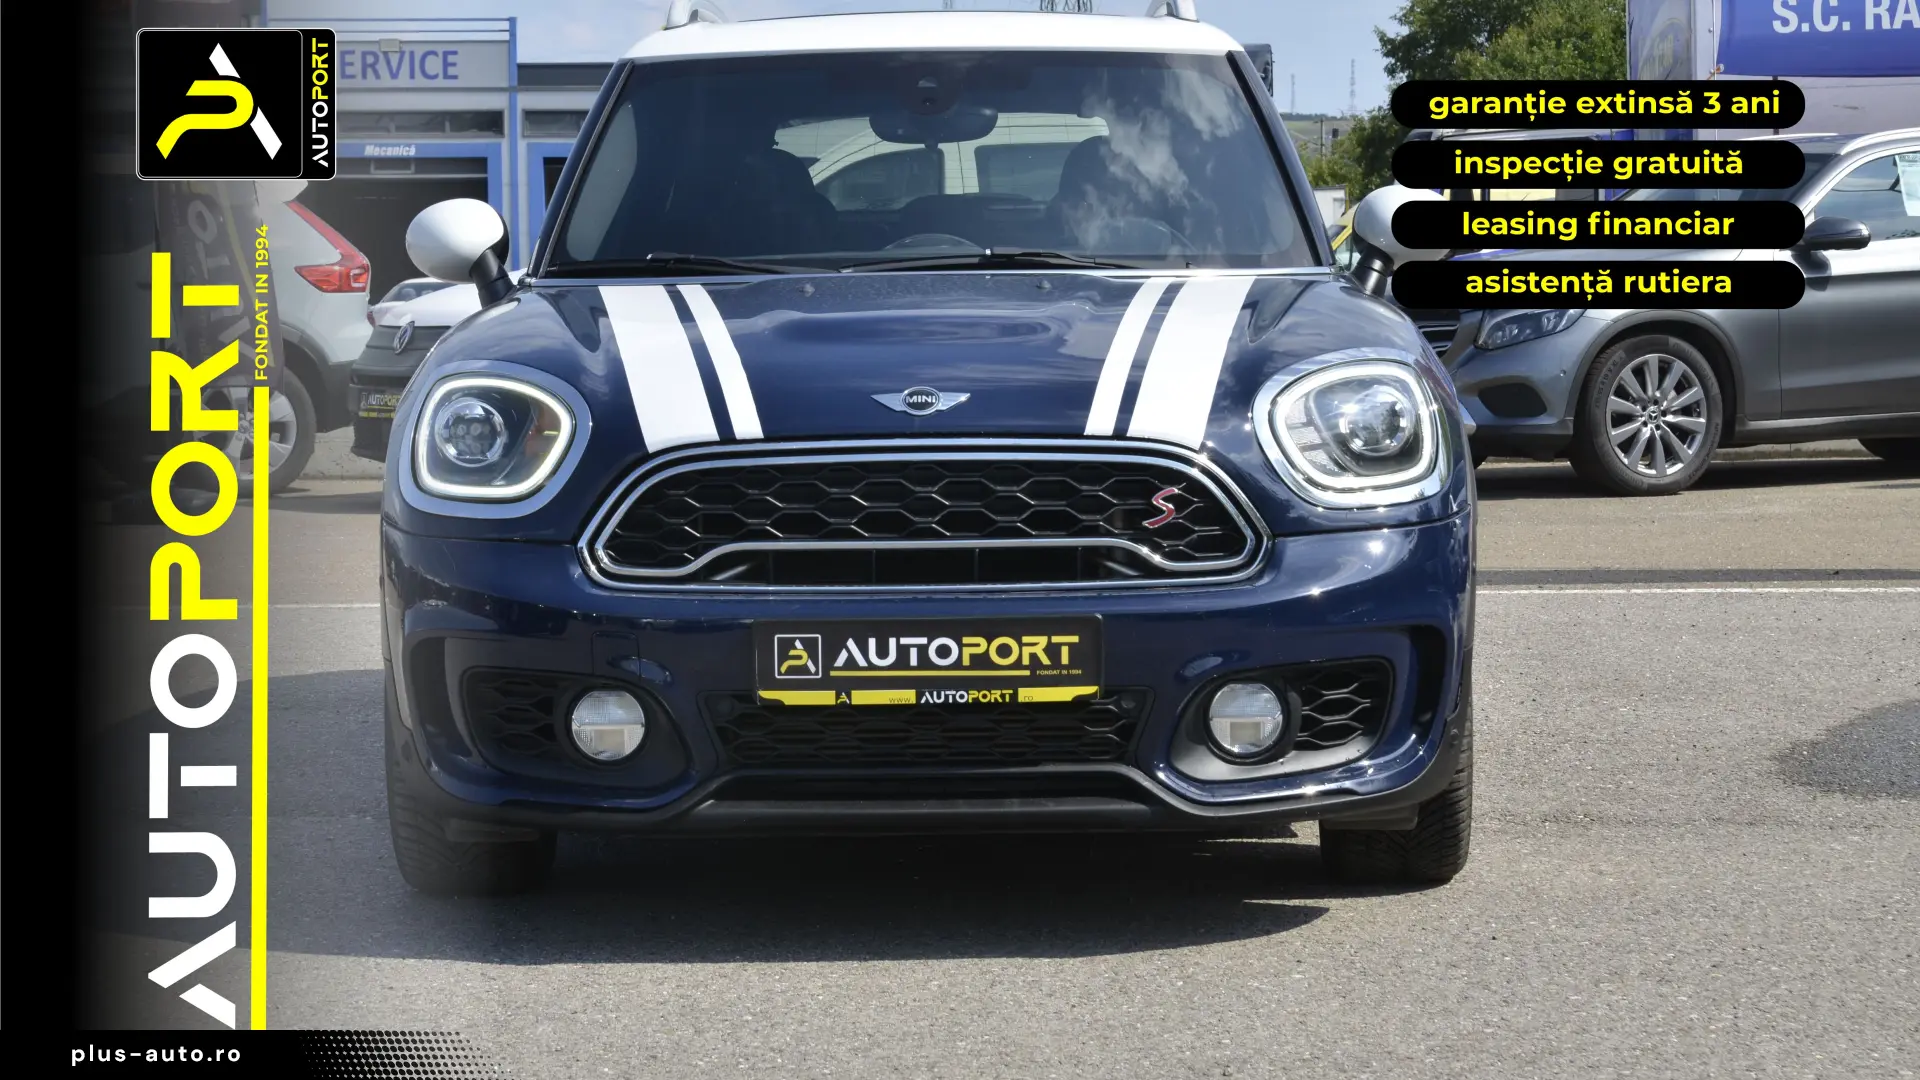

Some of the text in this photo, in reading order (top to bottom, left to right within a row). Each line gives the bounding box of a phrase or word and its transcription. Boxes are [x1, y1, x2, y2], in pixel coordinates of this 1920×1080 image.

[1772, 0, 1851, 34] S.C.
[906, 395, 936, 403] MINI
[1142, 487, 1179, 528] S
[833, 635, 1079, 667] AUTOPORT
[920, 689, 1013, 703] AUTOPORT
